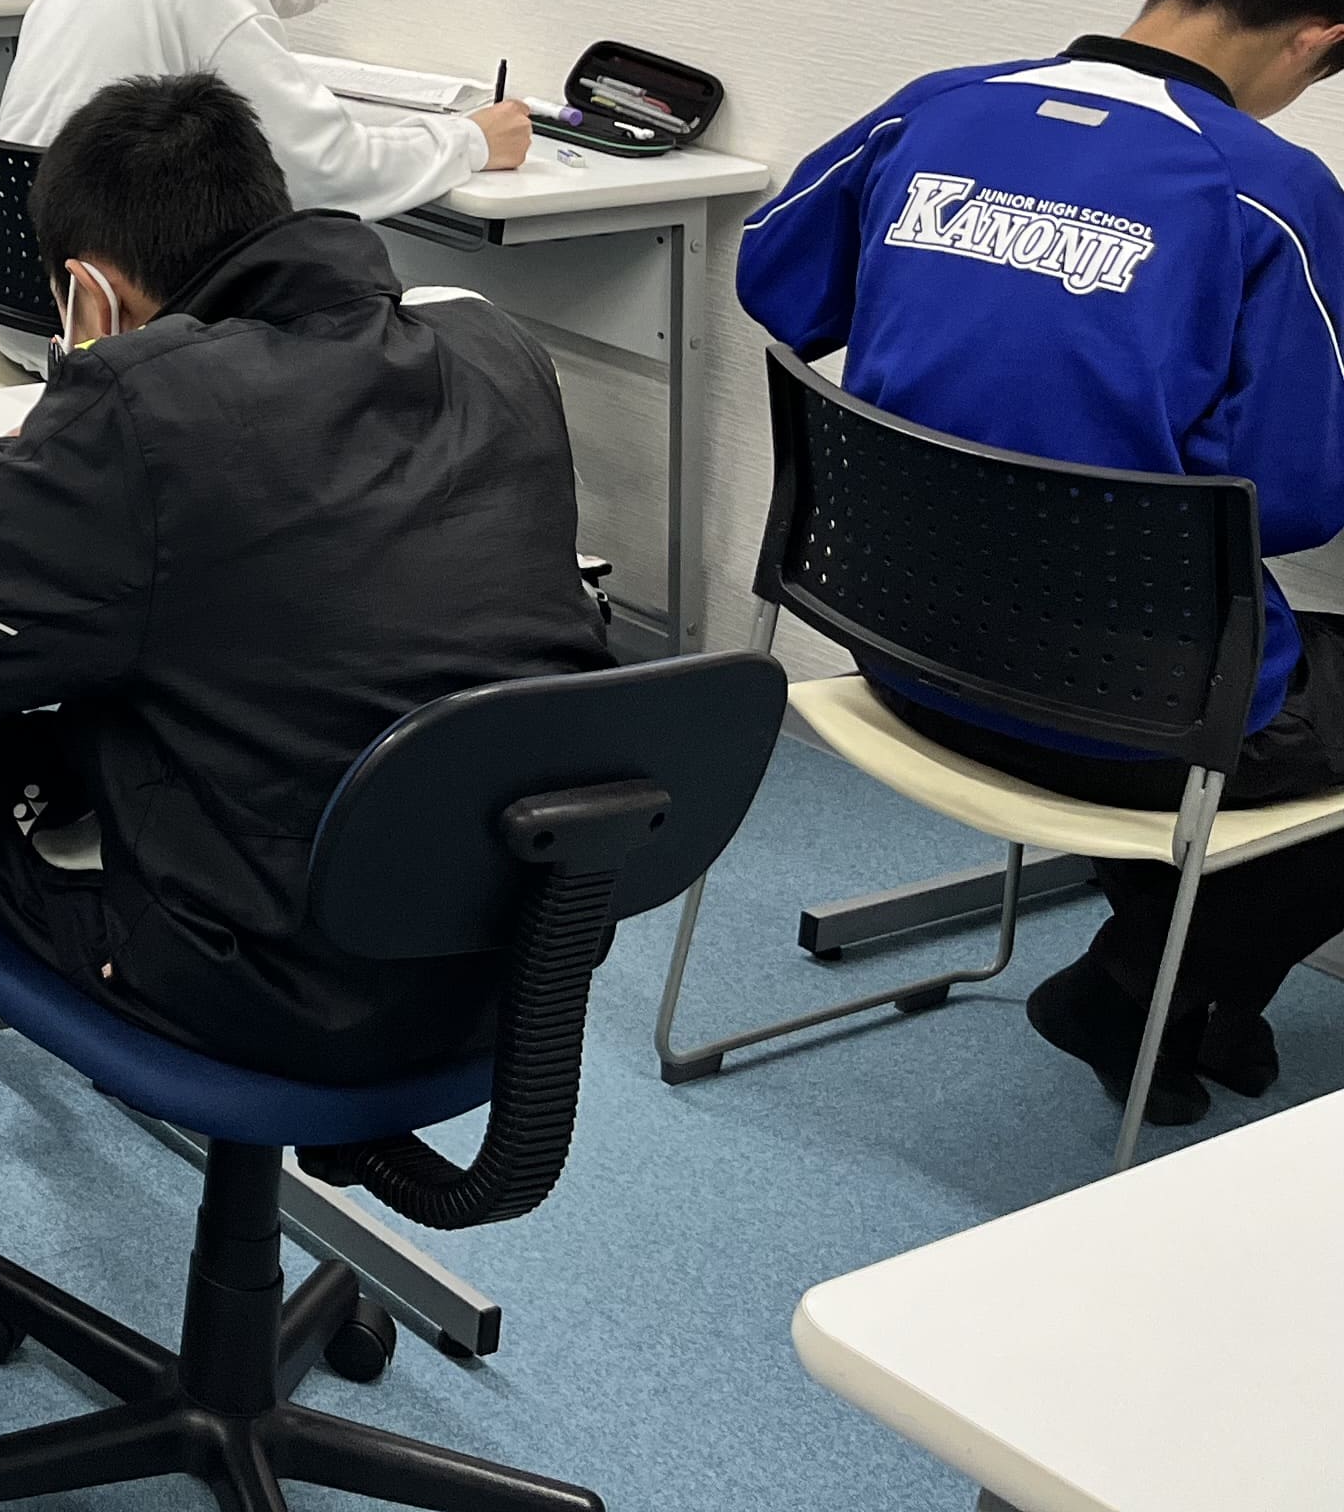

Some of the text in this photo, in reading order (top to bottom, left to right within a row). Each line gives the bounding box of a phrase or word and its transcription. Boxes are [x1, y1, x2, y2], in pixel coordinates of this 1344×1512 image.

[884, 172, 1154, 294] KANONJI
[975, 187, 1153, 240] JUNIOR HIGH SCHOOL
